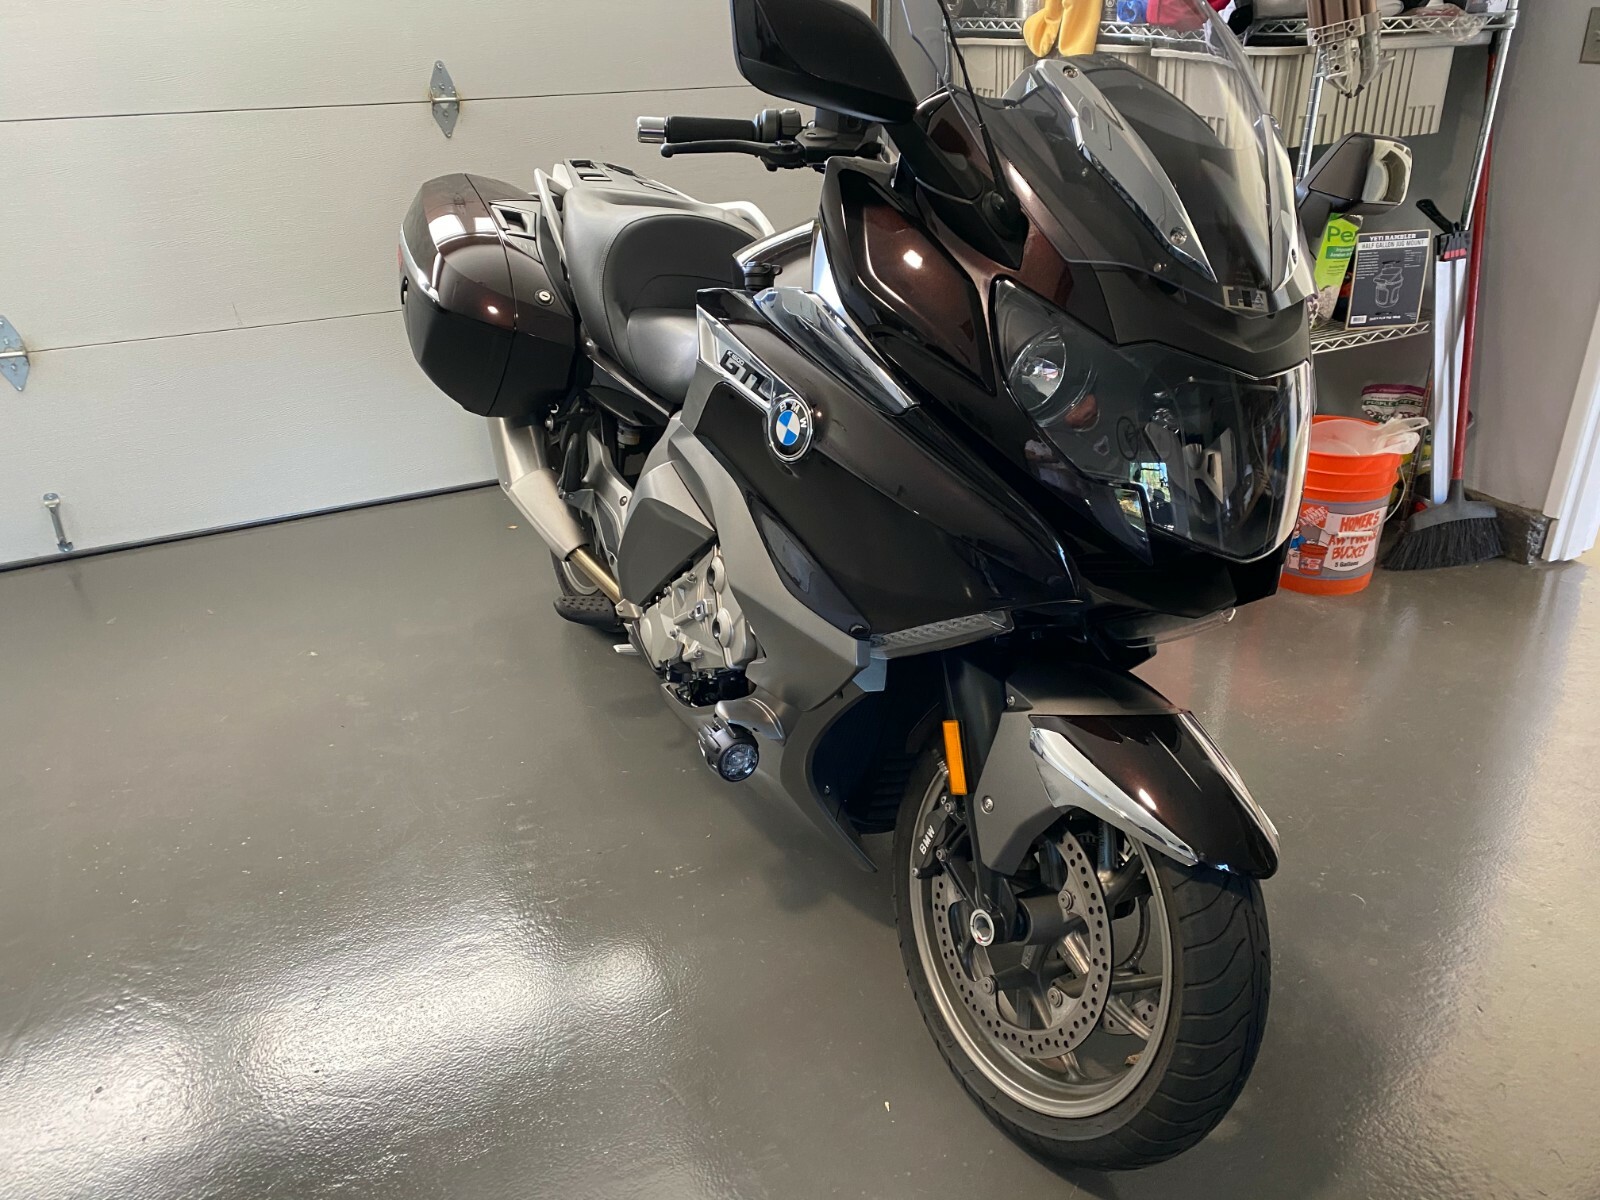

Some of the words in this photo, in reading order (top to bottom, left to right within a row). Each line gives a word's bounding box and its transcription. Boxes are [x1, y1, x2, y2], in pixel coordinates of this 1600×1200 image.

[1327, 225, 1357, 243] Pe
[720, 350, 771, 402] GTL
[779, 401, 808, 428] BMW
[1332, 544, 1369, 560] BUCKET
[919, 825, 935, 855] BMW
